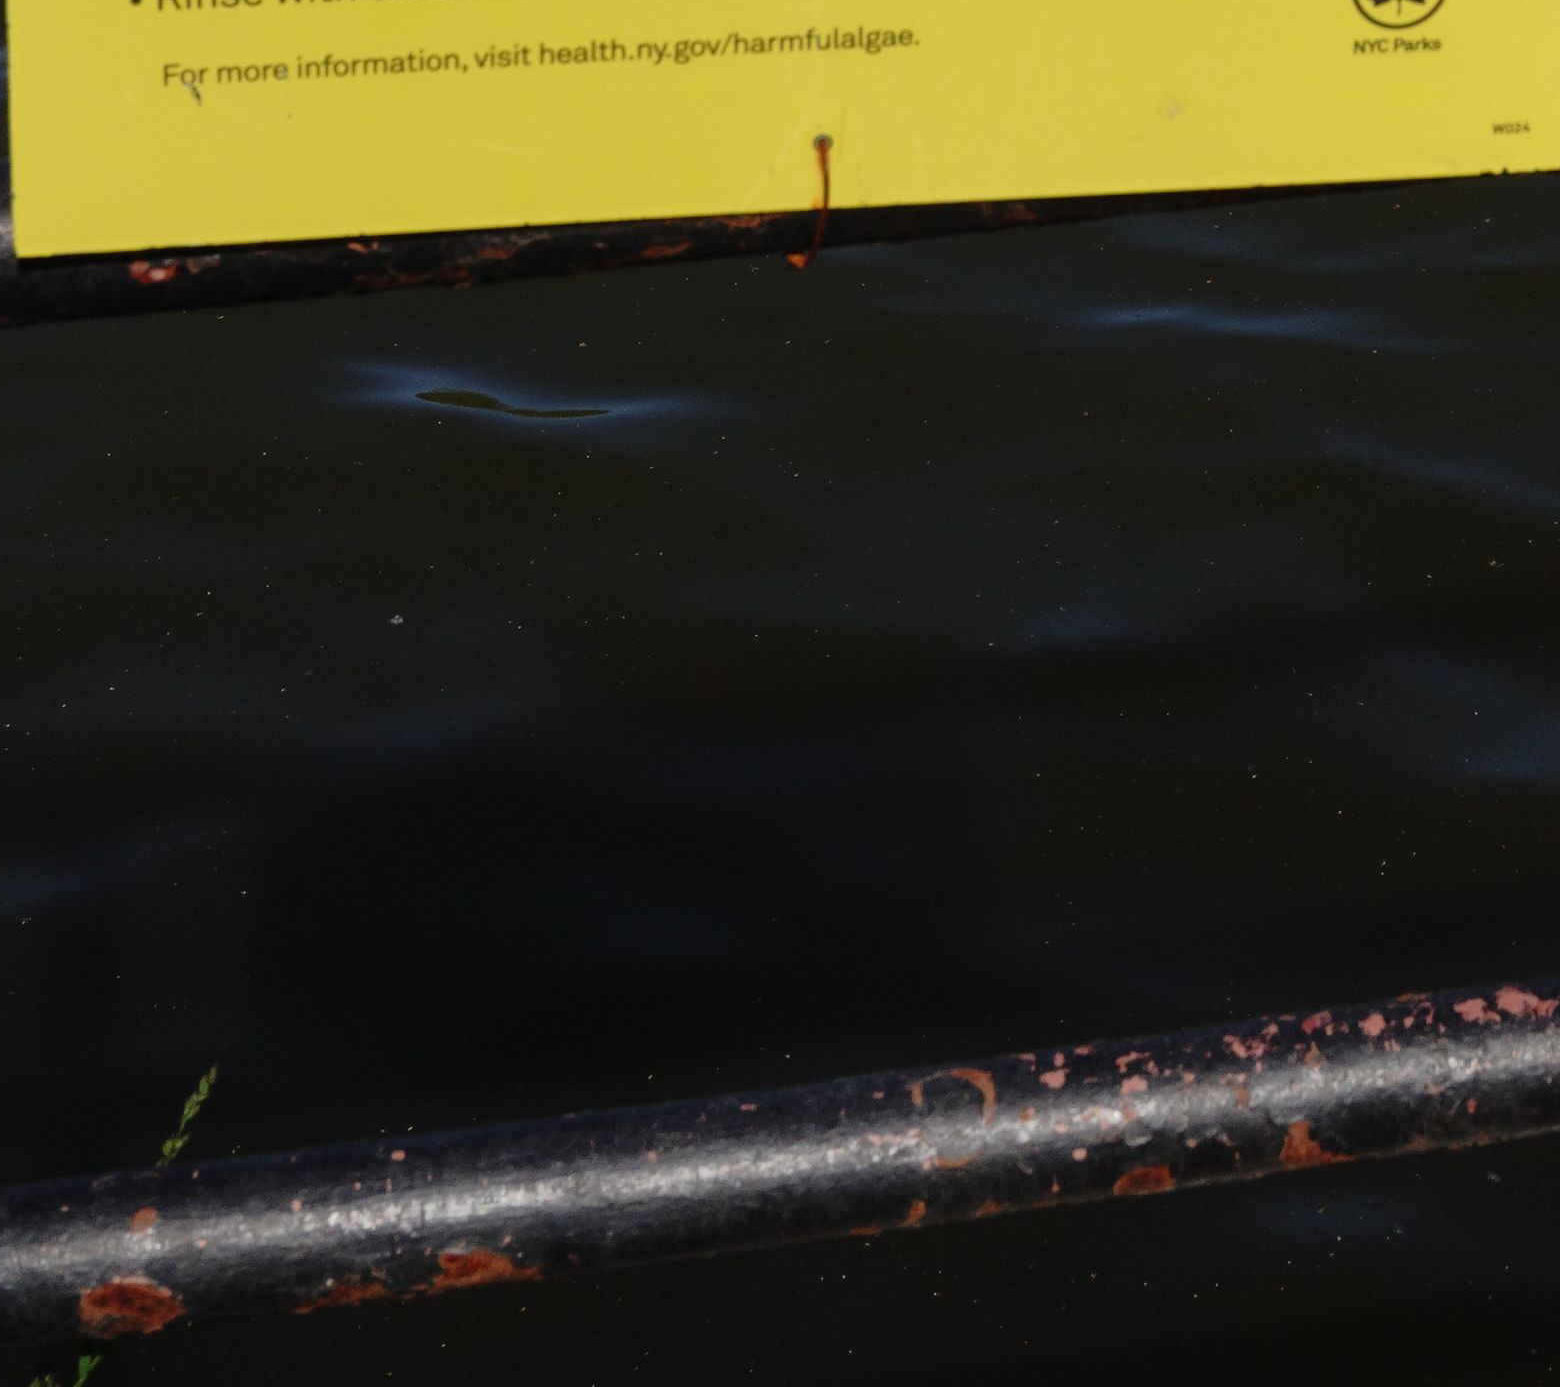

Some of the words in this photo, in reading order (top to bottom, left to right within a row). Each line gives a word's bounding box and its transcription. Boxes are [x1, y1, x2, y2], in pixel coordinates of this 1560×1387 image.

[162, 62, 209, 86] For
[215, 62, 289, 84] more
[296, 47, 468, 79] information,
[473, 42, 532, 70] visit
[538, 26, 920, 66] health.ny.gov/harmfulalgae.
[1353, 38, 1389, 55] NYC
[1392, 36, 1442, 53] Parks
